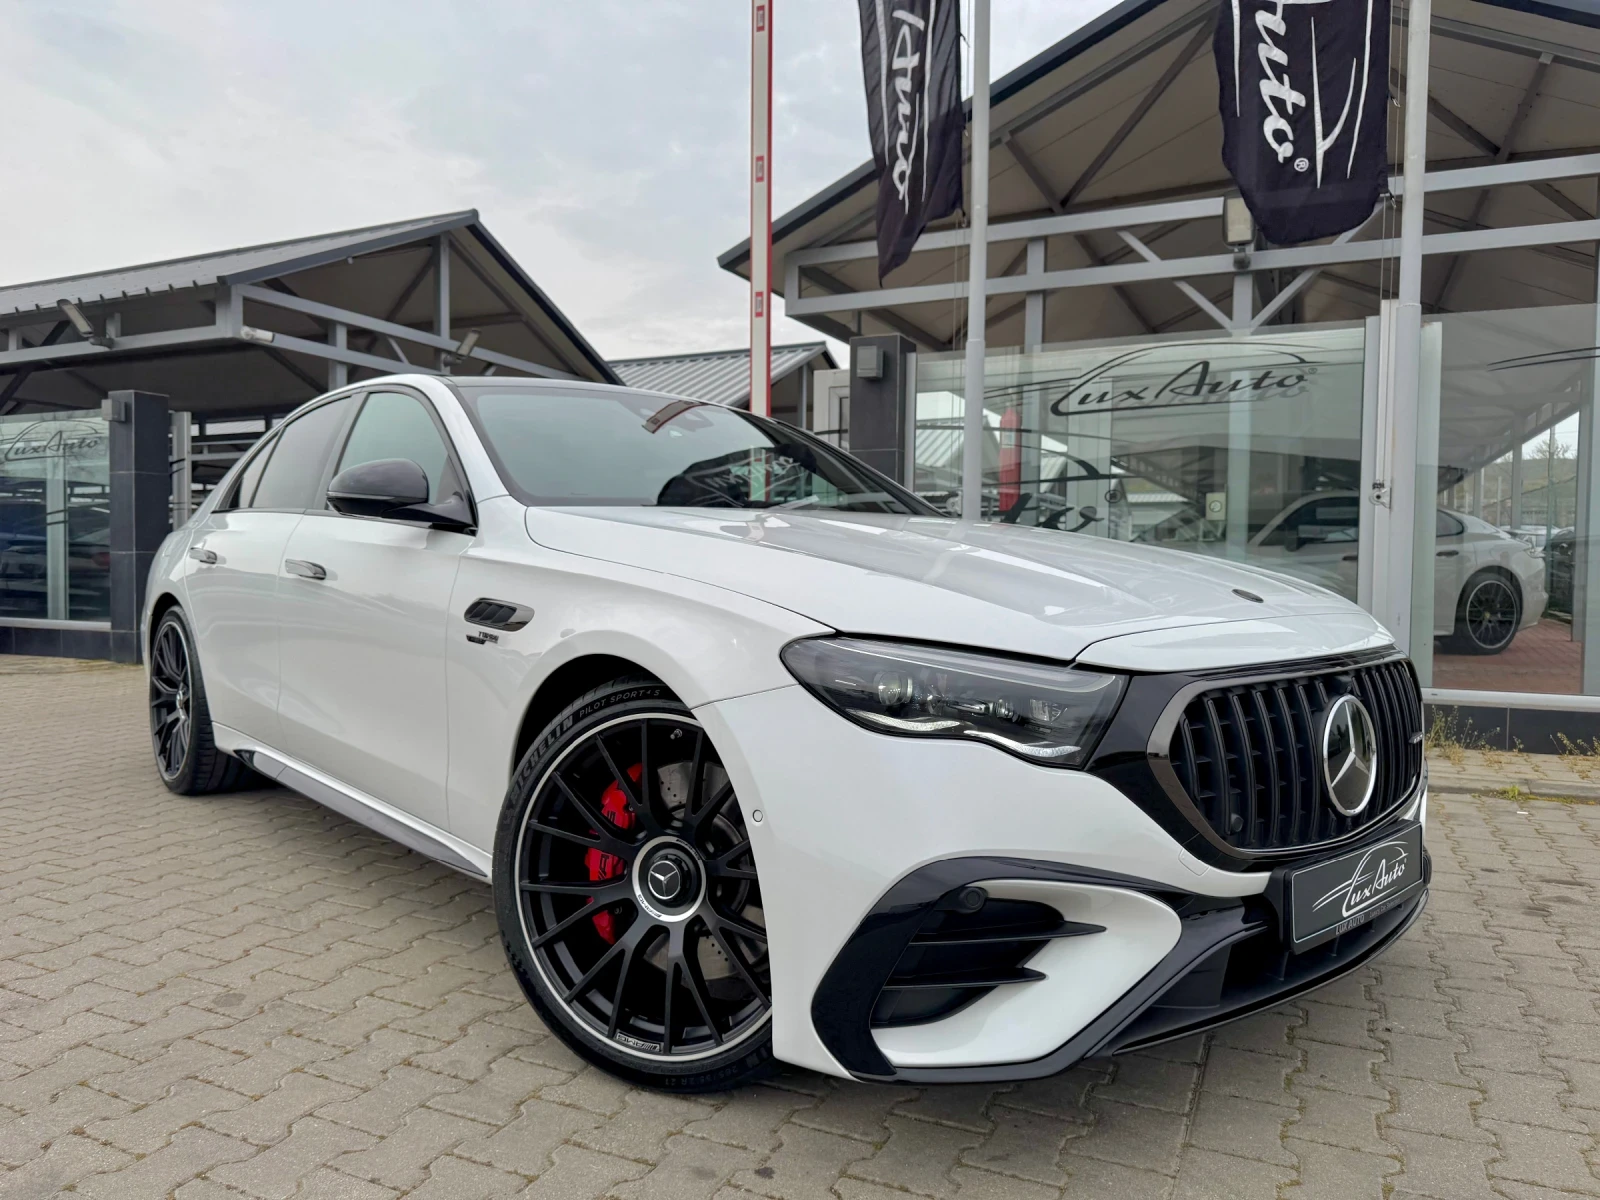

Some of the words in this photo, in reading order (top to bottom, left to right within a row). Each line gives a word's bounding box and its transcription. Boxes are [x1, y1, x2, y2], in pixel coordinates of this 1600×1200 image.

[1155, 360, 1308, 399] Auto
[510, 715, 574, 804] MICHELIN
[579, 700, 607, 718] PILOT
[609, 689, 645, 704] SPORT
[1371, 858, 1406, 894] Auto
[1347, 914, 1365, 930] AUTO
